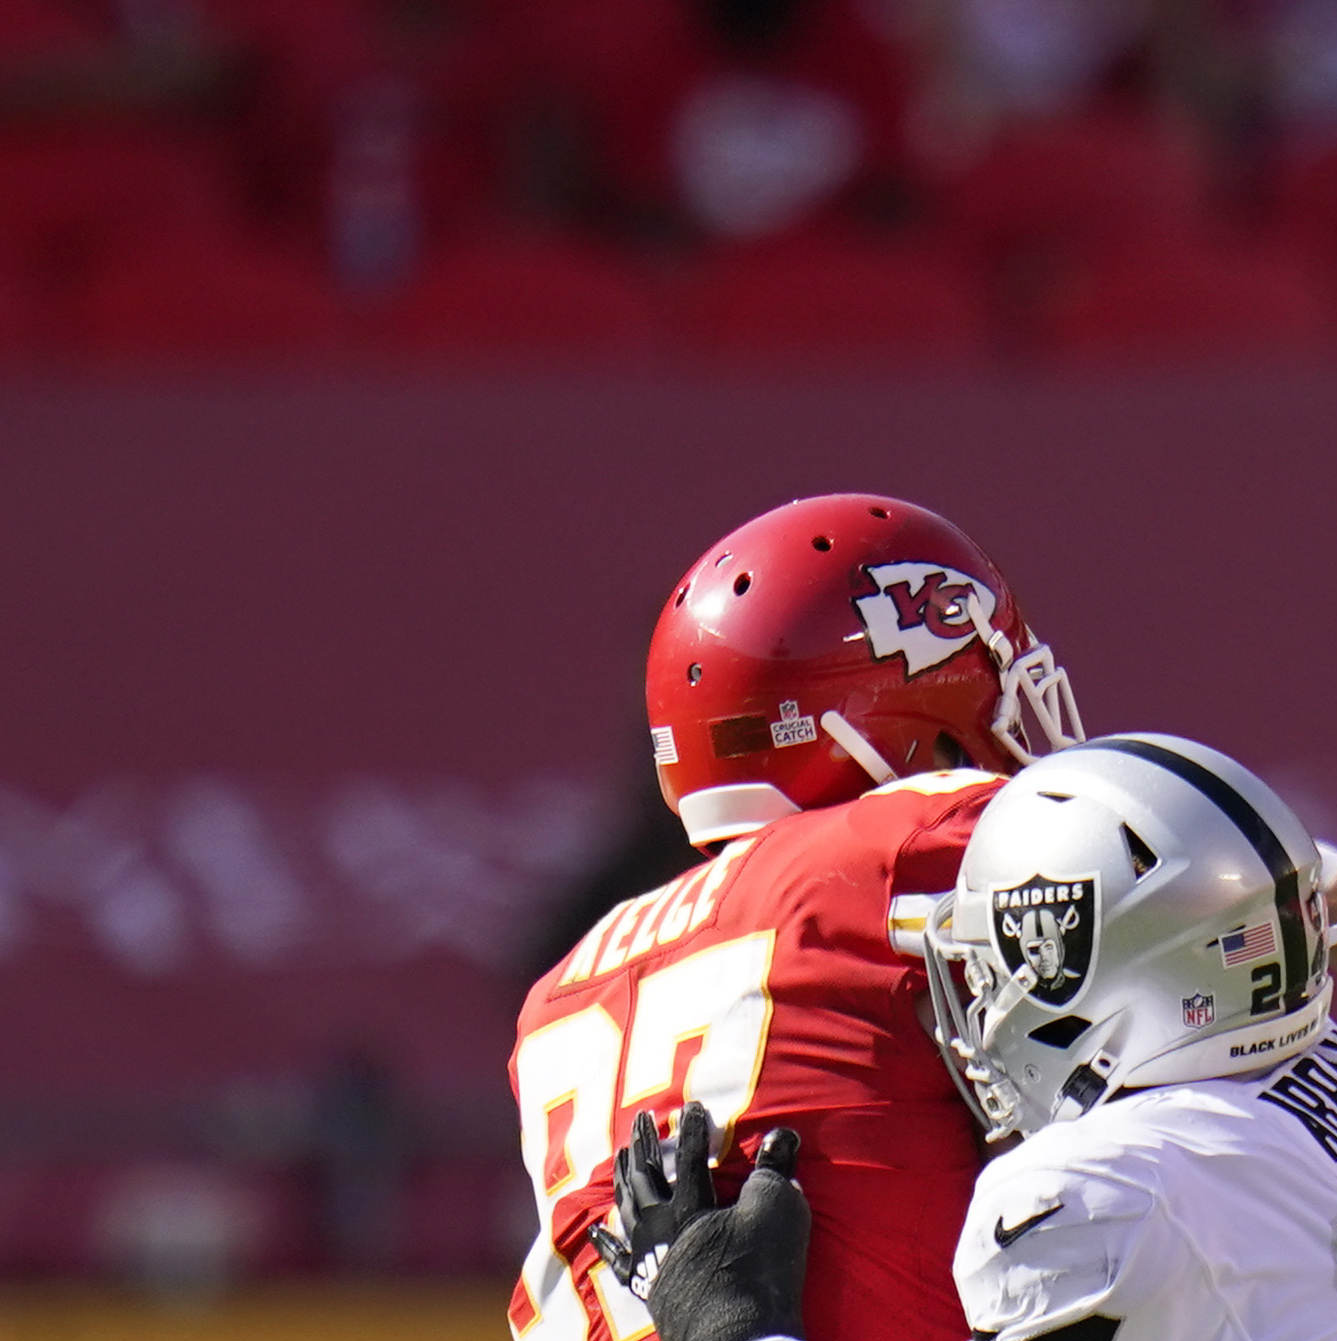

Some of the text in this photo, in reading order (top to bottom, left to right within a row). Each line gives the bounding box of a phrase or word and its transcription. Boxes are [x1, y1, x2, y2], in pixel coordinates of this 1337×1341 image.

[883, 571, 980, 640] KC
[773, 719, 811, 733] CRUCIAL
[775, 726, 813, 743] CATCH
[998, 882, 1084, 909] RAIDERS
[1186, 1007, 1212, 1026] NFL
[1229, 1038, 1277, 1058] BLACK
